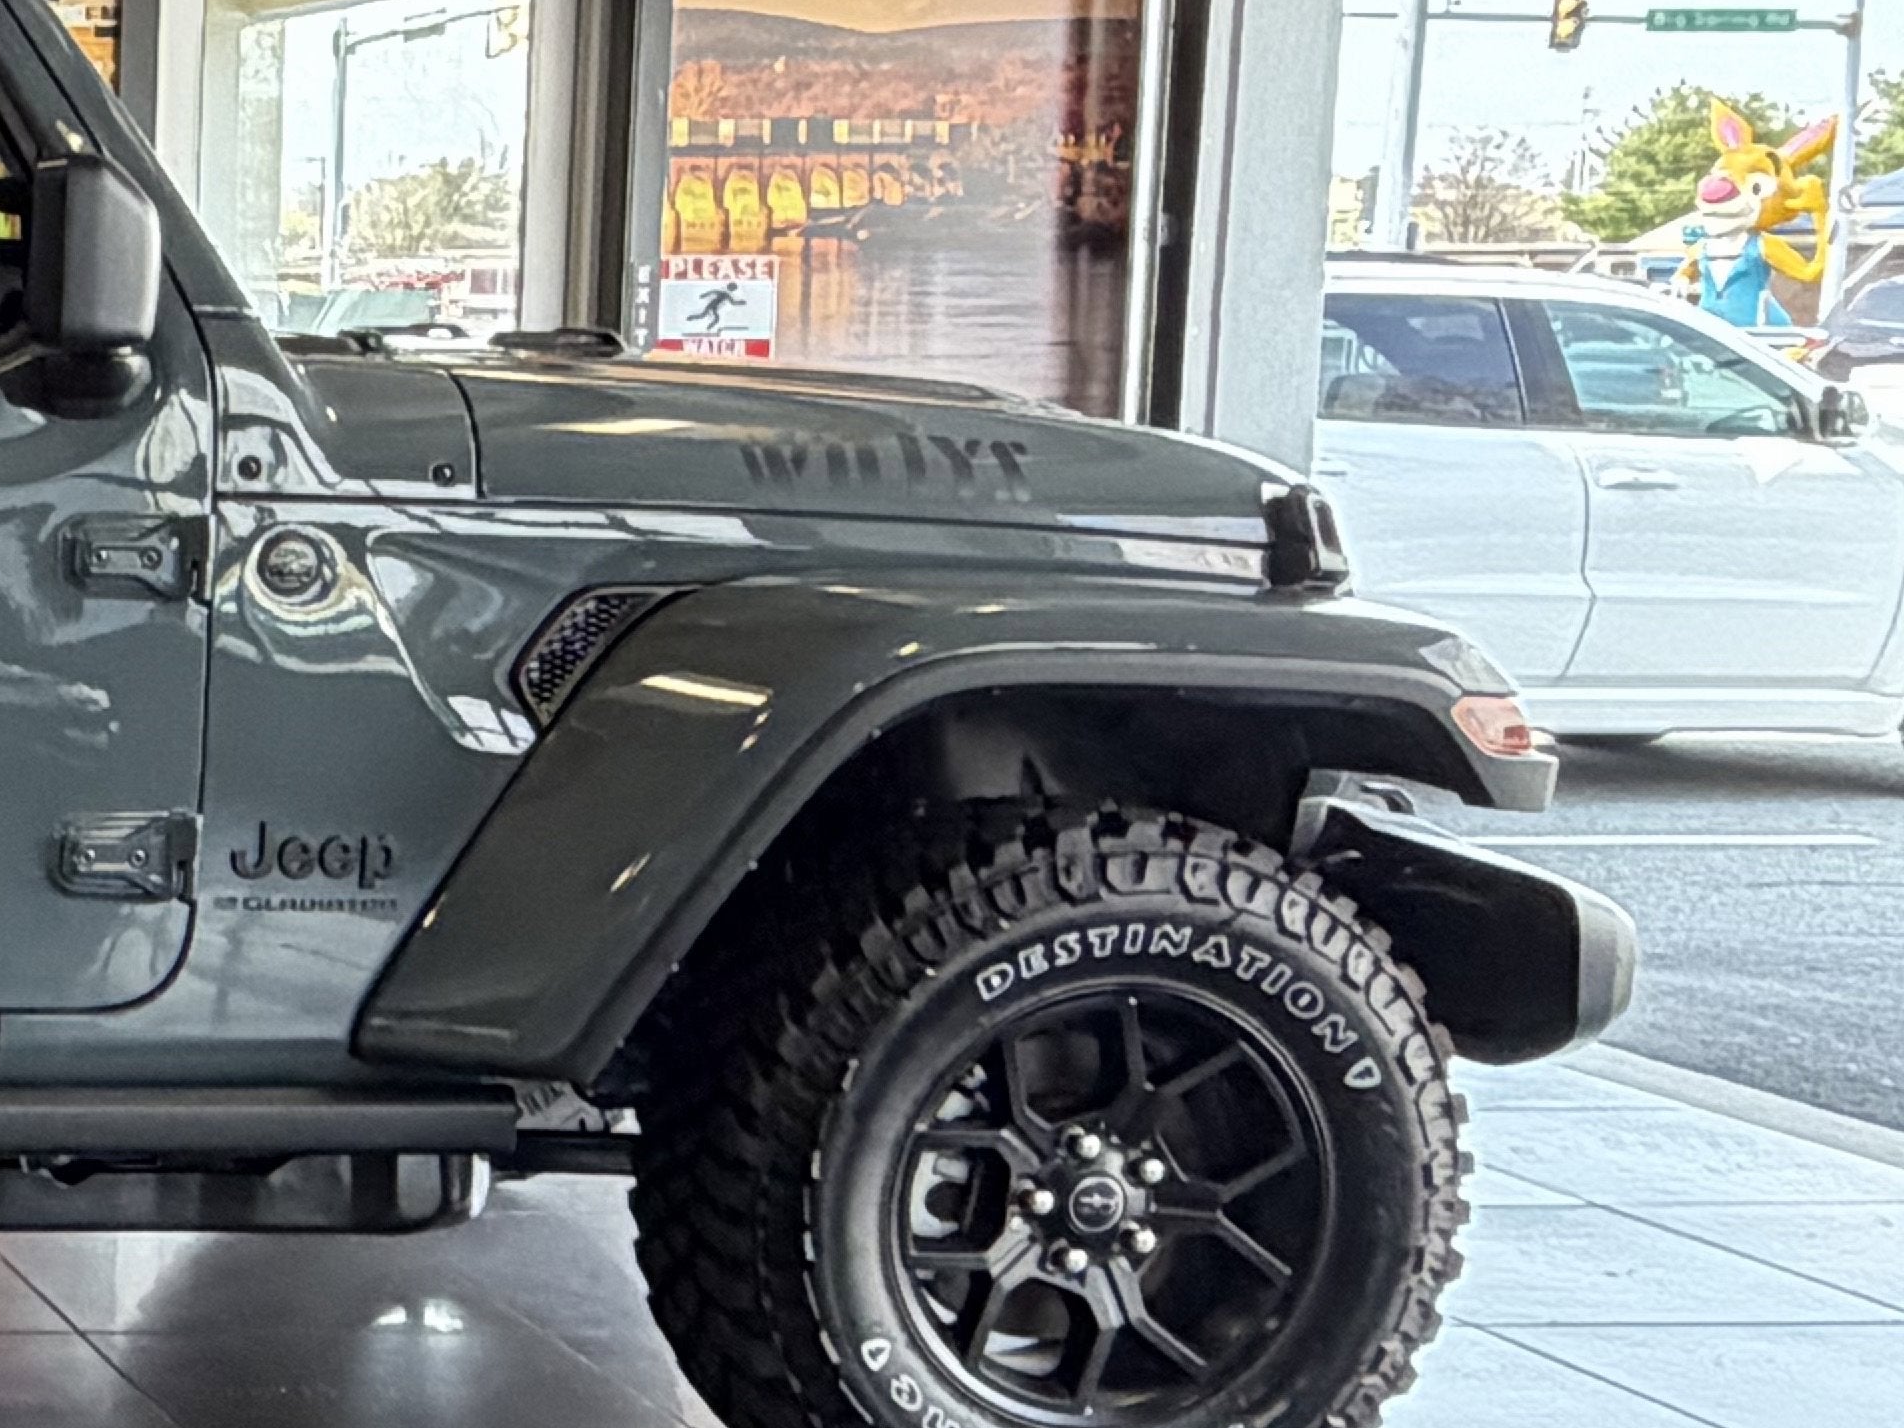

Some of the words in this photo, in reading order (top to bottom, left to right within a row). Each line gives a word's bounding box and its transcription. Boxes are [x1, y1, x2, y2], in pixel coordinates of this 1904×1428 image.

[668, 257, 773, 280] PLEASE
[634, 264, 652, 347] EXIT
[686, 338, 743, 358] WATCH
[229, 820, 394, 890] Jeep
[975, 921, 1359, 1055] DESTINATION
